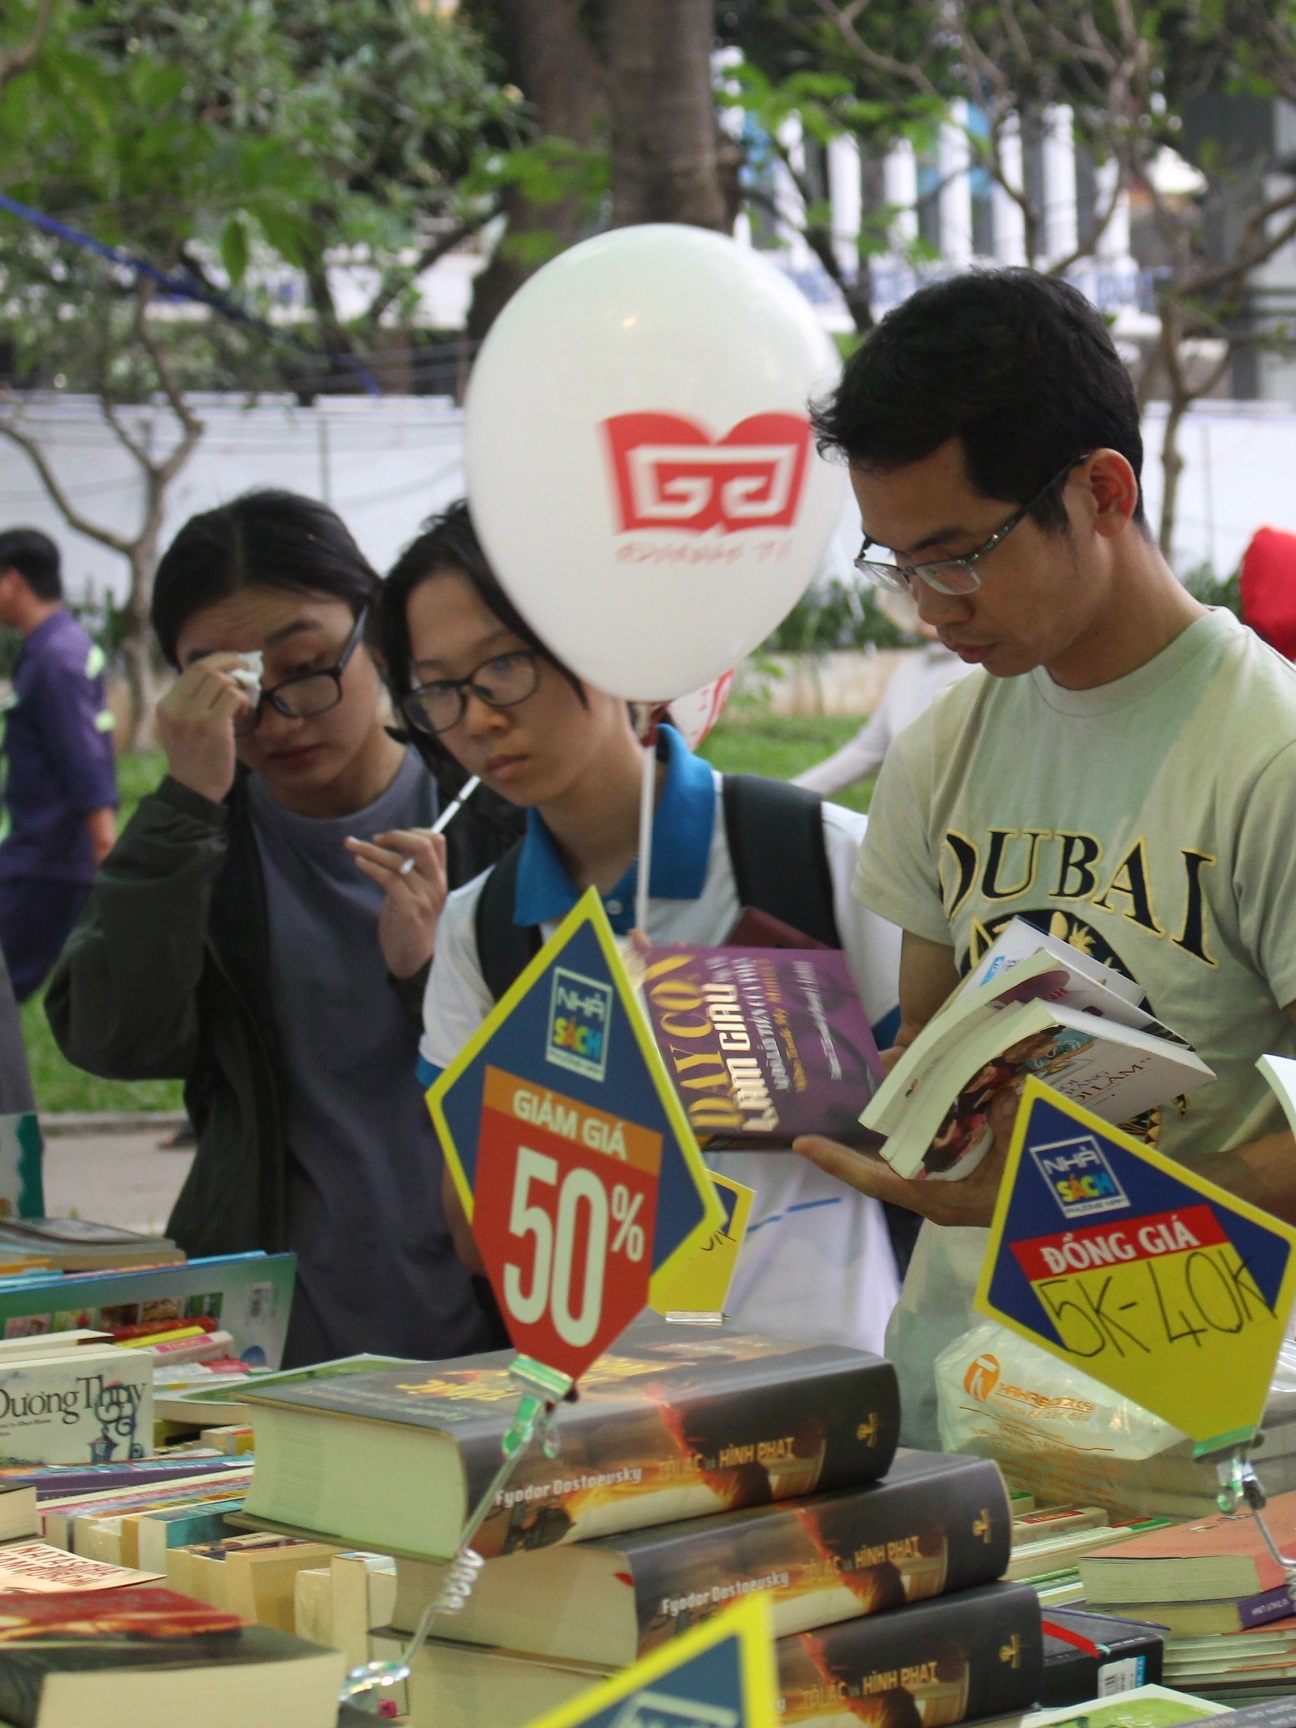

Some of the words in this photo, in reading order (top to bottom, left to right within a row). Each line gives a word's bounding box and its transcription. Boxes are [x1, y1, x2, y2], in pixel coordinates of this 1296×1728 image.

[938, 828, 1220, 970] DUBAI
[555, 985, 606, 1022] NHÀ
[553, 1015, 604, 1060] SÁCH
[513, 1089, 578, 1140] GIẢM
[582, 1118, 628, 1162] GIÁ
[1044, 1145, 1101, 1177] NHÀ
[1055, 1171, 1117, 1203] SÁCH
[503, 1146, 646, 1347] 50%
[1039, 1232, 1137, 1276] ĐỒNG
[1137, 1214, 1201, 1256] GIÁ
